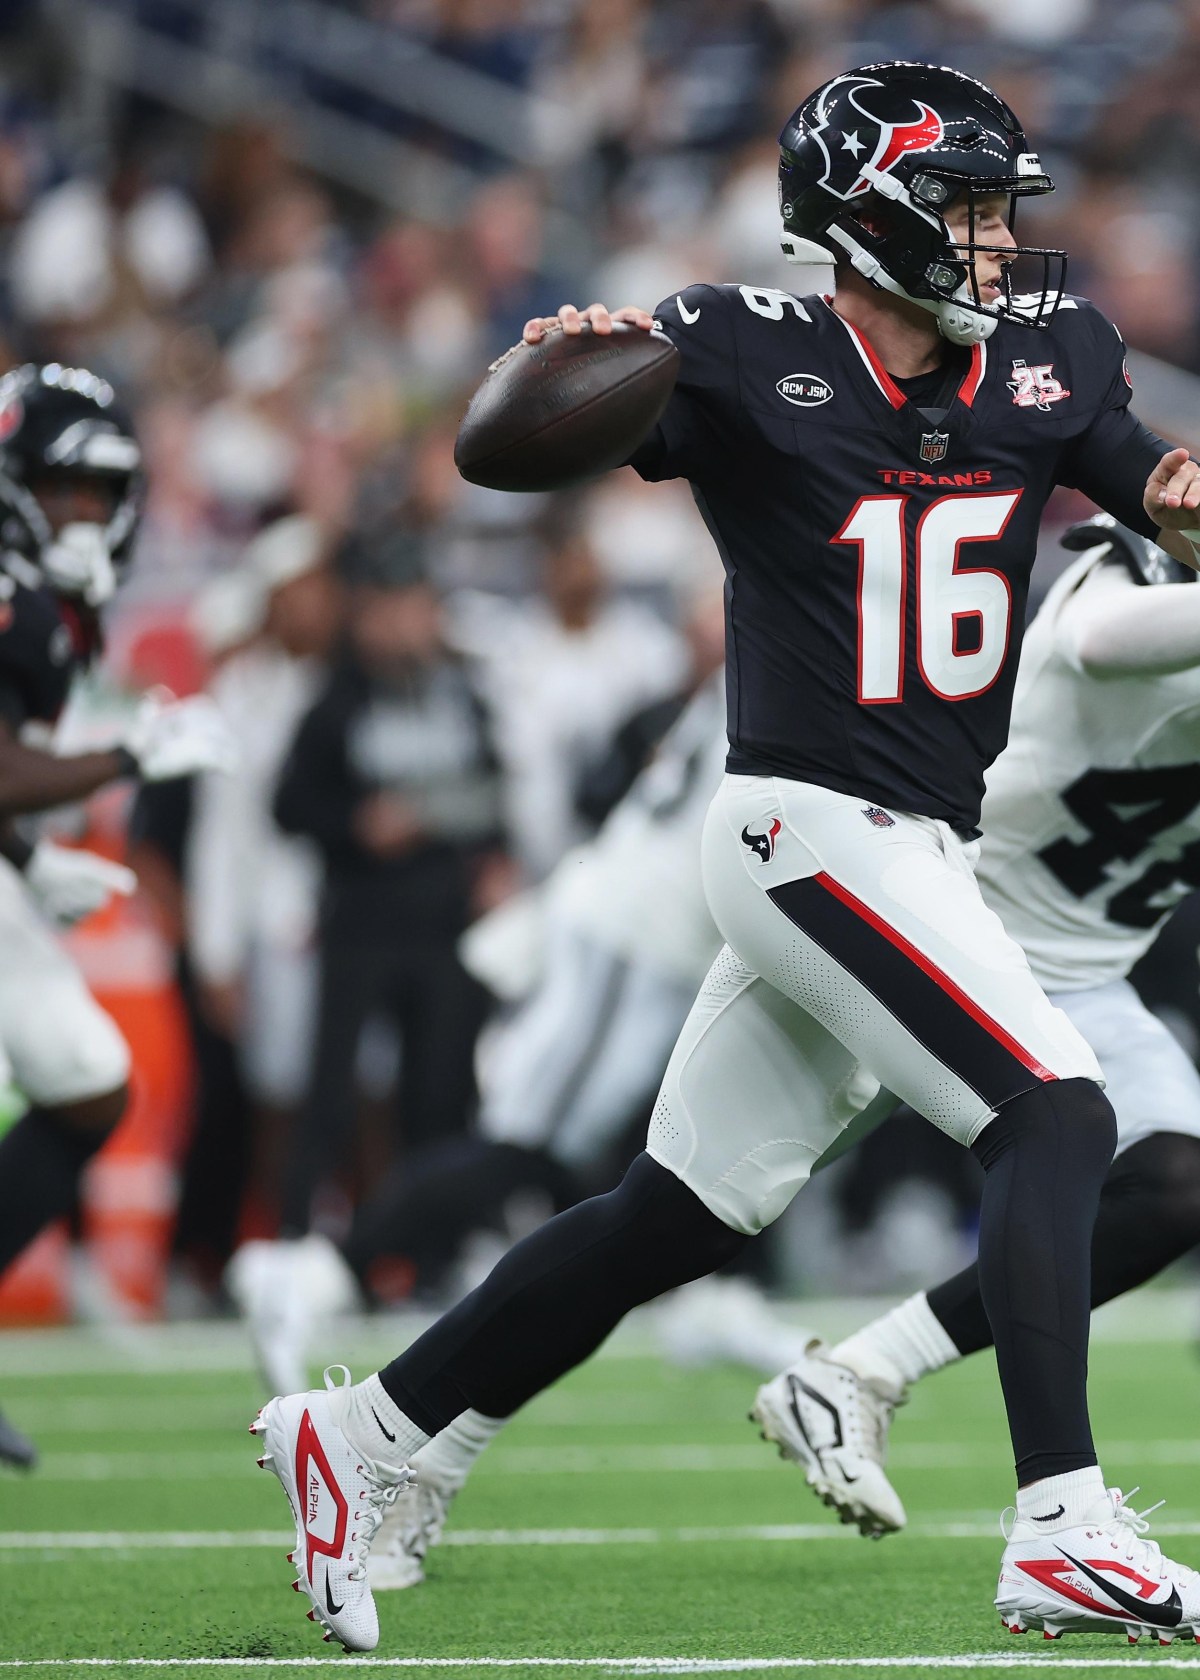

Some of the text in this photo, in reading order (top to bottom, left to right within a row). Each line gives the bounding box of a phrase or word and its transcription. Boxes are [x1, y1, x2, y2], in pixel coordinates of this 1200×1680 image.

[728, 284, 813, 322] 6
[782, 381, 828, 399] RCM JSM
[923, 446, 943, 459] NFL
[877, 469, 993, 487] TEXANS
[828, 487, 1025, 705] 16
[308, 1473, 320, 1524] ALPHA
[1062, 1575, 1095, 1600] ALPHA
